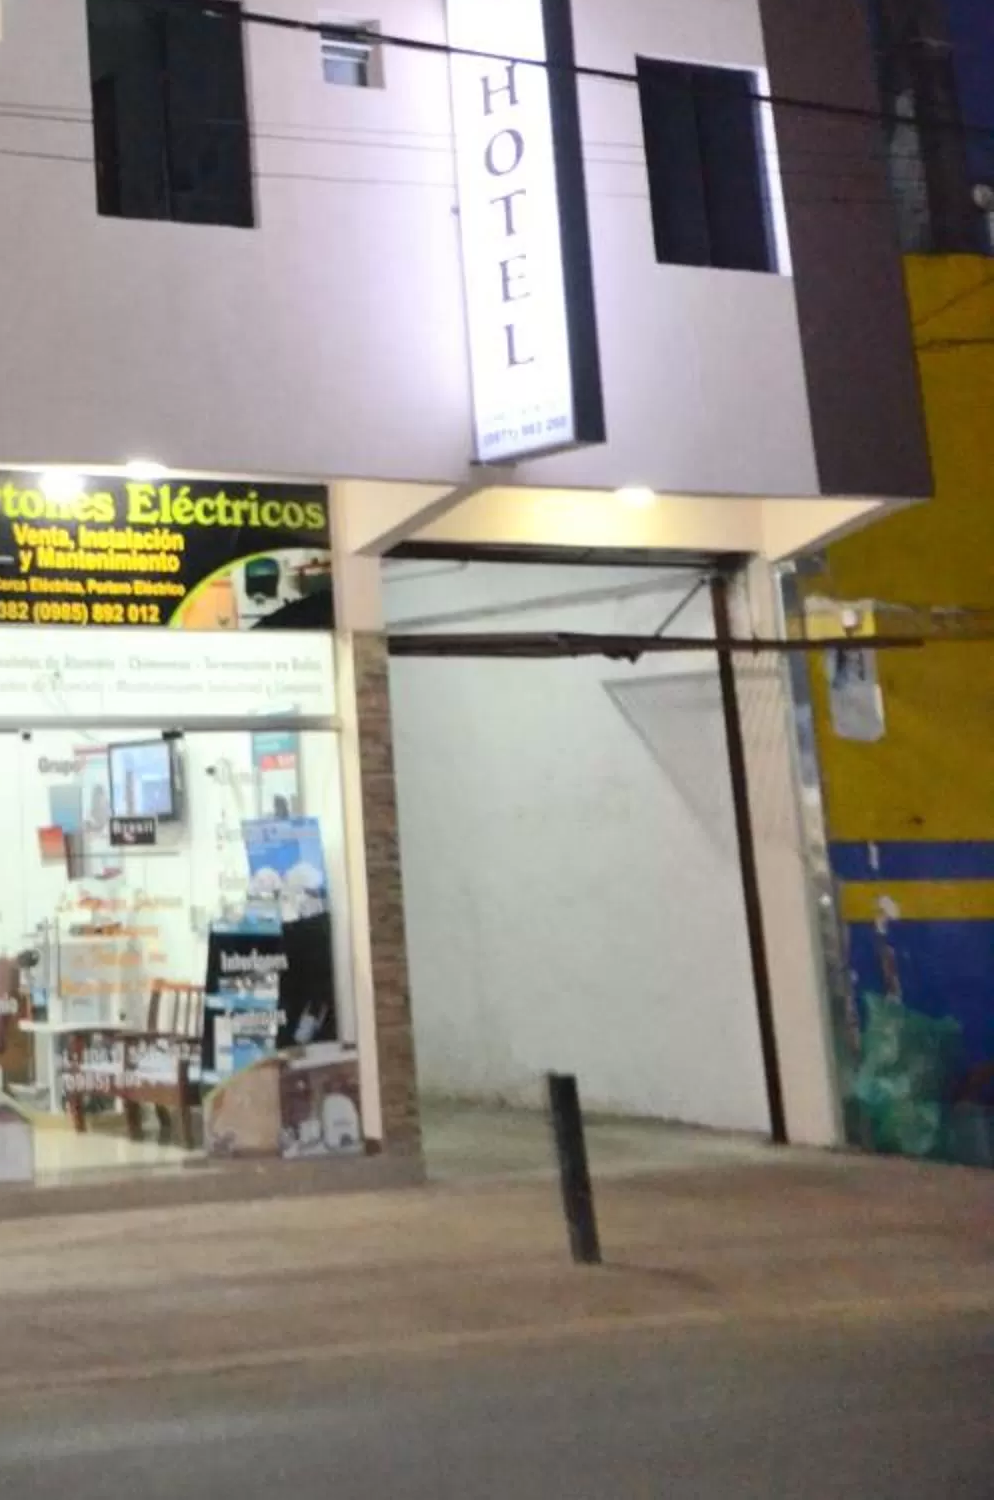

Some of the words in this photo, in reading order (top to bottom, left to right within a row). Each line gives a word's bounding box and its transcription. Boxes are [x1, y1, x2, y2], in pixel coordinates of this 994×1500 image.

[479, 60, 535, 370] HOTEL
[126, 481, 325, 530] Eléctricos
[12, 523, 75, 549] Venta,
[79, 525, 185, 551] Instalación
[19, 549, 33, 572] y
[36, 547, 180, 572] Mantenimiento
[92, 603, 124, 623] 892
[128, 604, 160, 623] 012
